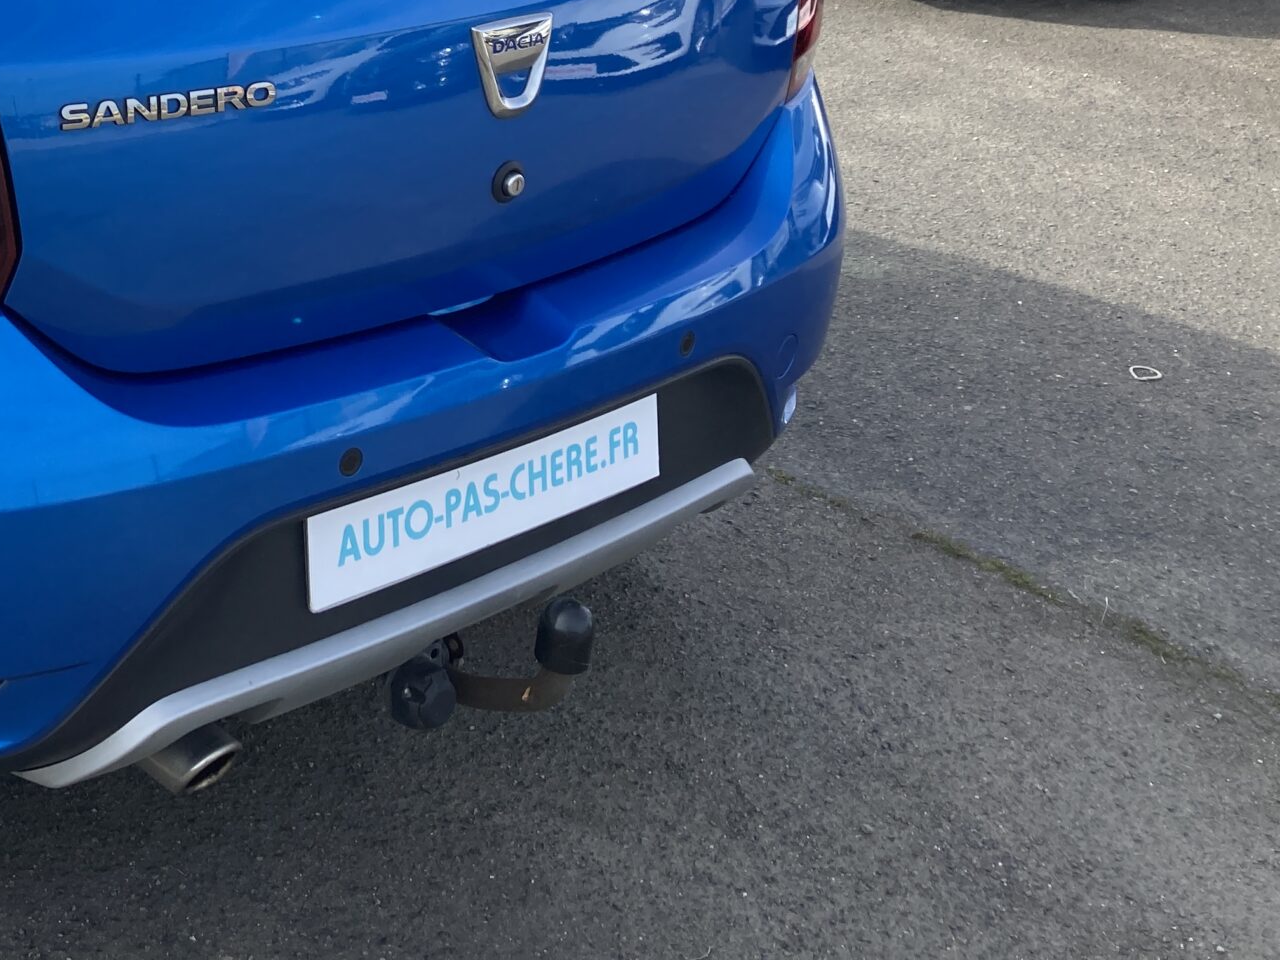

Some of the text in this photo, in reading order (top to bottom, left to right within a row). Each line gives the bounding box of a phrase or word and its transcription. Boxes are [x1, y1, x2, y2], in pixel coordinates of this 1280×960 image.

[492, 32, 544, 54] DACIA
[60, 80, 277, 131] SANDERO
[338, 420, 639, 568] AUTO-PAS-CHERE.FR
